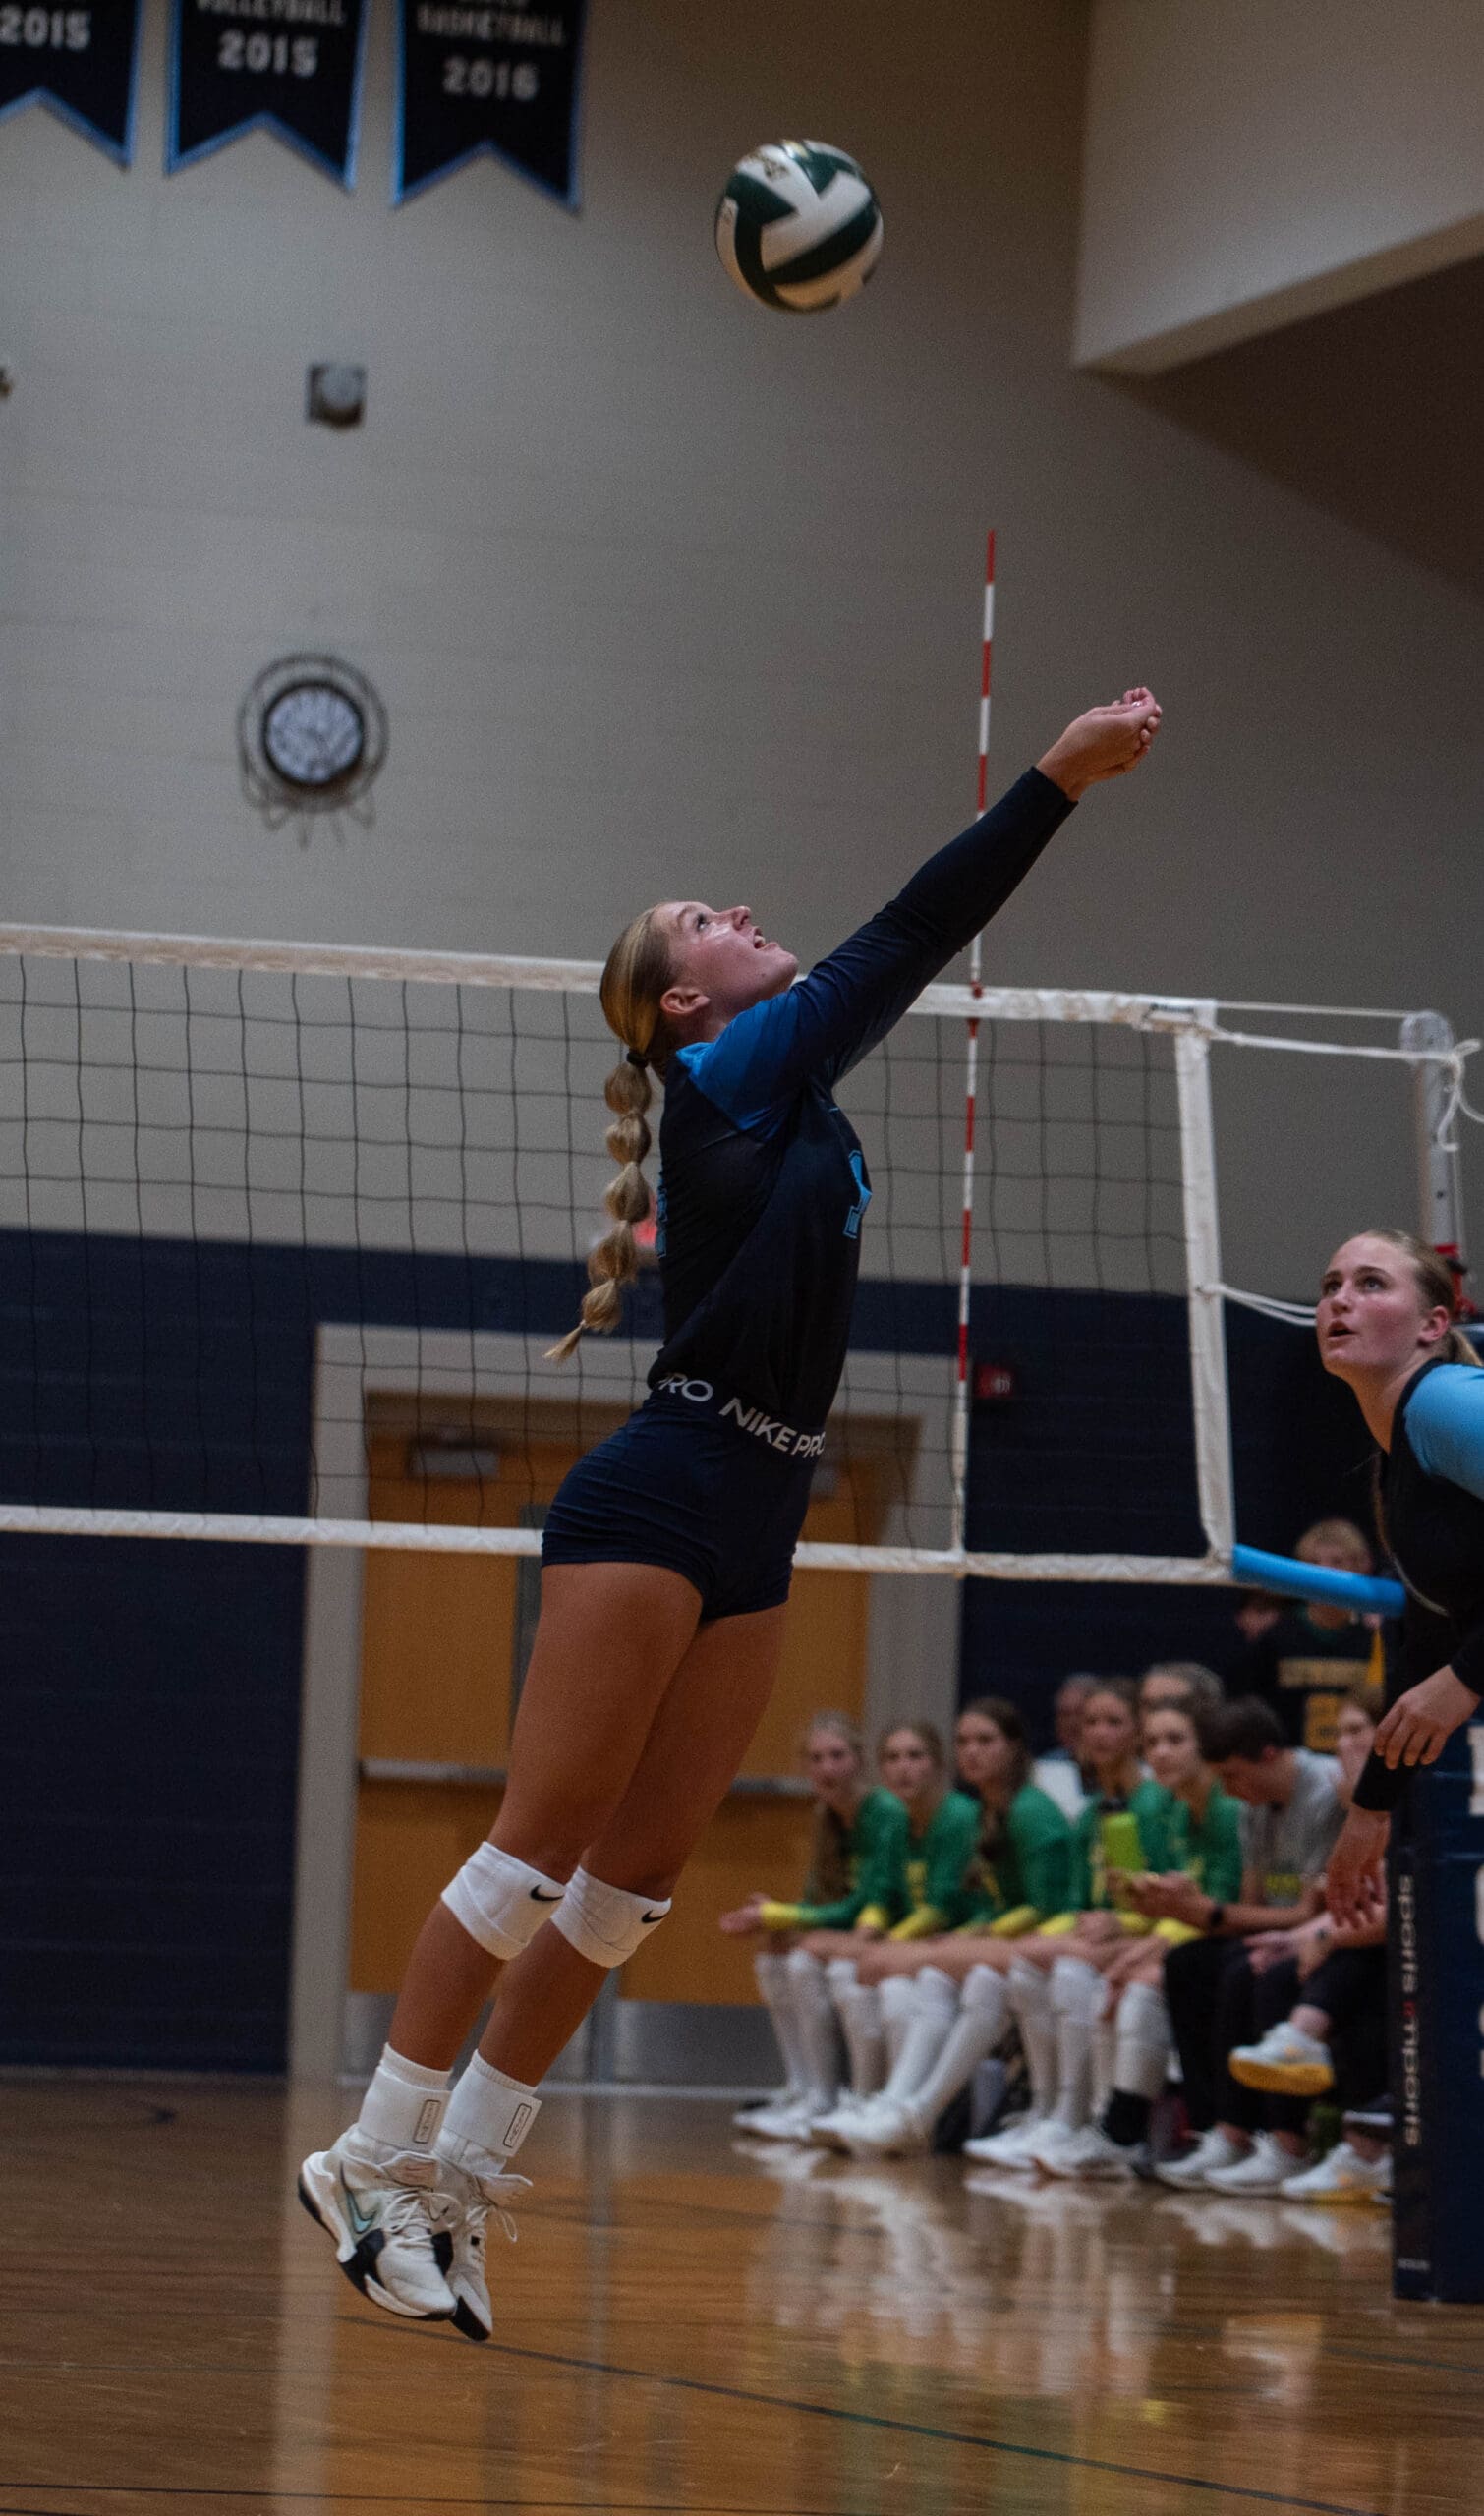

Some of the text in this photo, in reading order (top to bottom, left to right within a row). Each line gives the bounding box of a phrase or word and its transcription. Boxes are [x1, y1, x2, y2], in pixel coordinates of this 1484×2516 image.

[0, 8, 91, 51] 2015
[215, 29, 318, 78] 2015
[441, 54, 539, 102] 2016
[1397, 1874, 1419, 1994] sports
